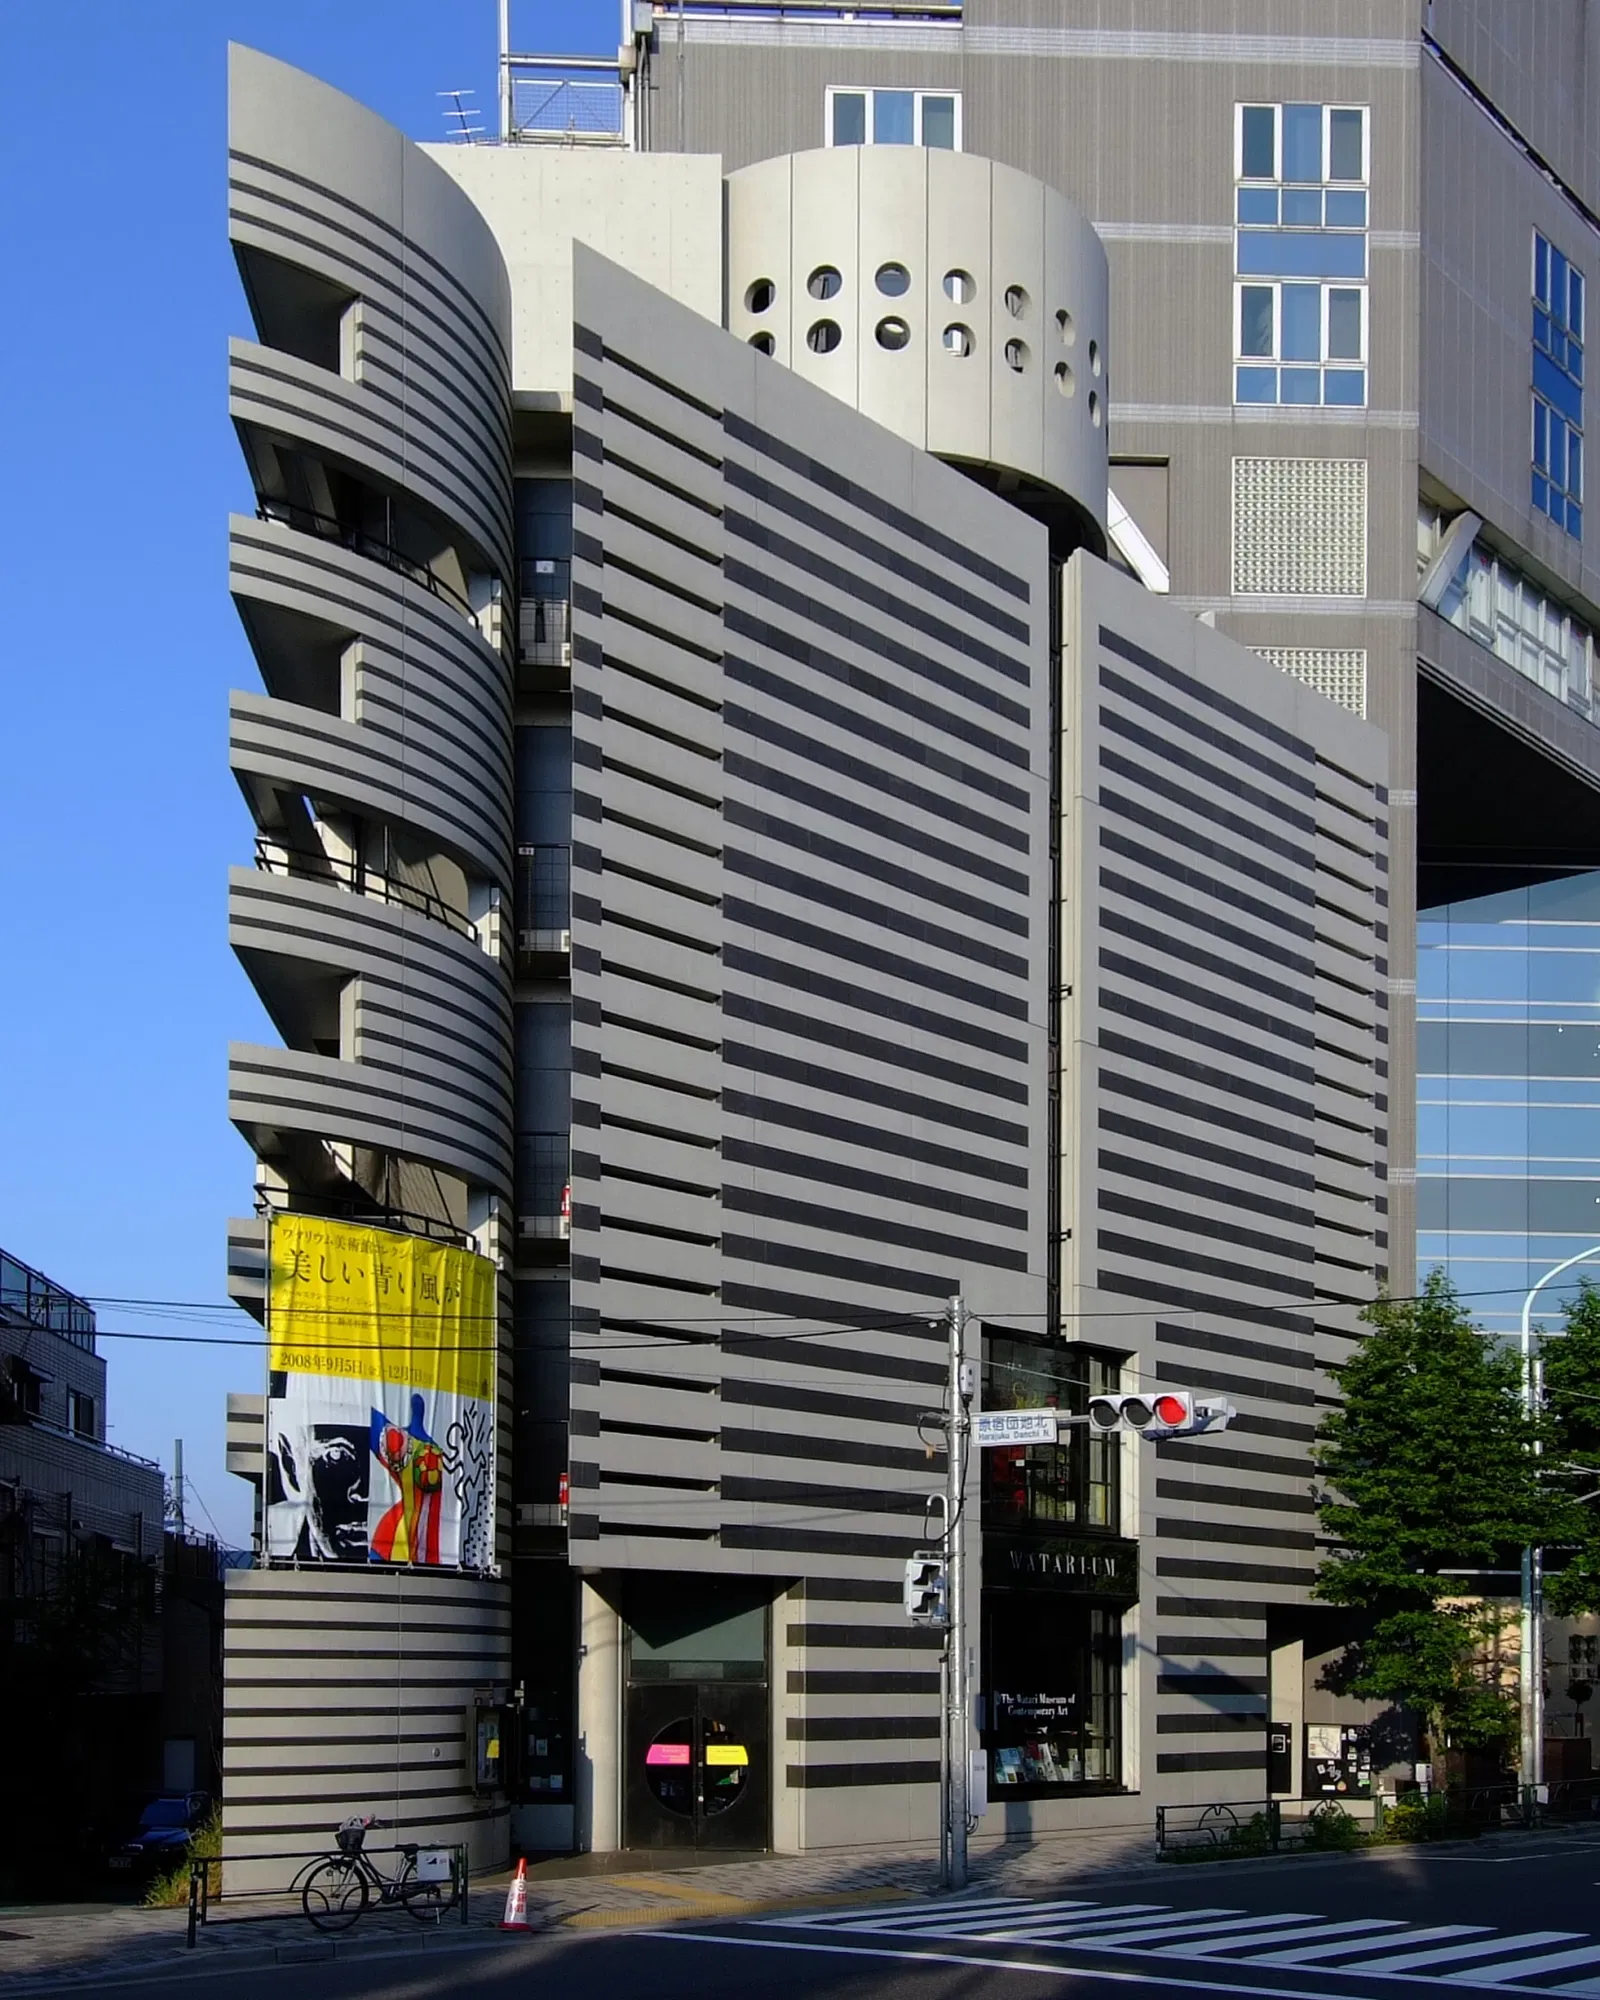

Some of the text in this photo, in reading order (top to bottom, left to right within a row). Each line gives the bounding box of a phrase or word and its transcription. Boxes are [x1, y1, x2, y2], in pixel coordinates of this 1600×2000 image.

[282, 1249, 460, 1304] 美しい青い風が
[1000, 1693, 1015, 1704] The
[1039, 1692, 1067, 1704] Museum
[1067, 1692, 1076, 1704] of
[1057, 1705, 1068, 1715] Art
